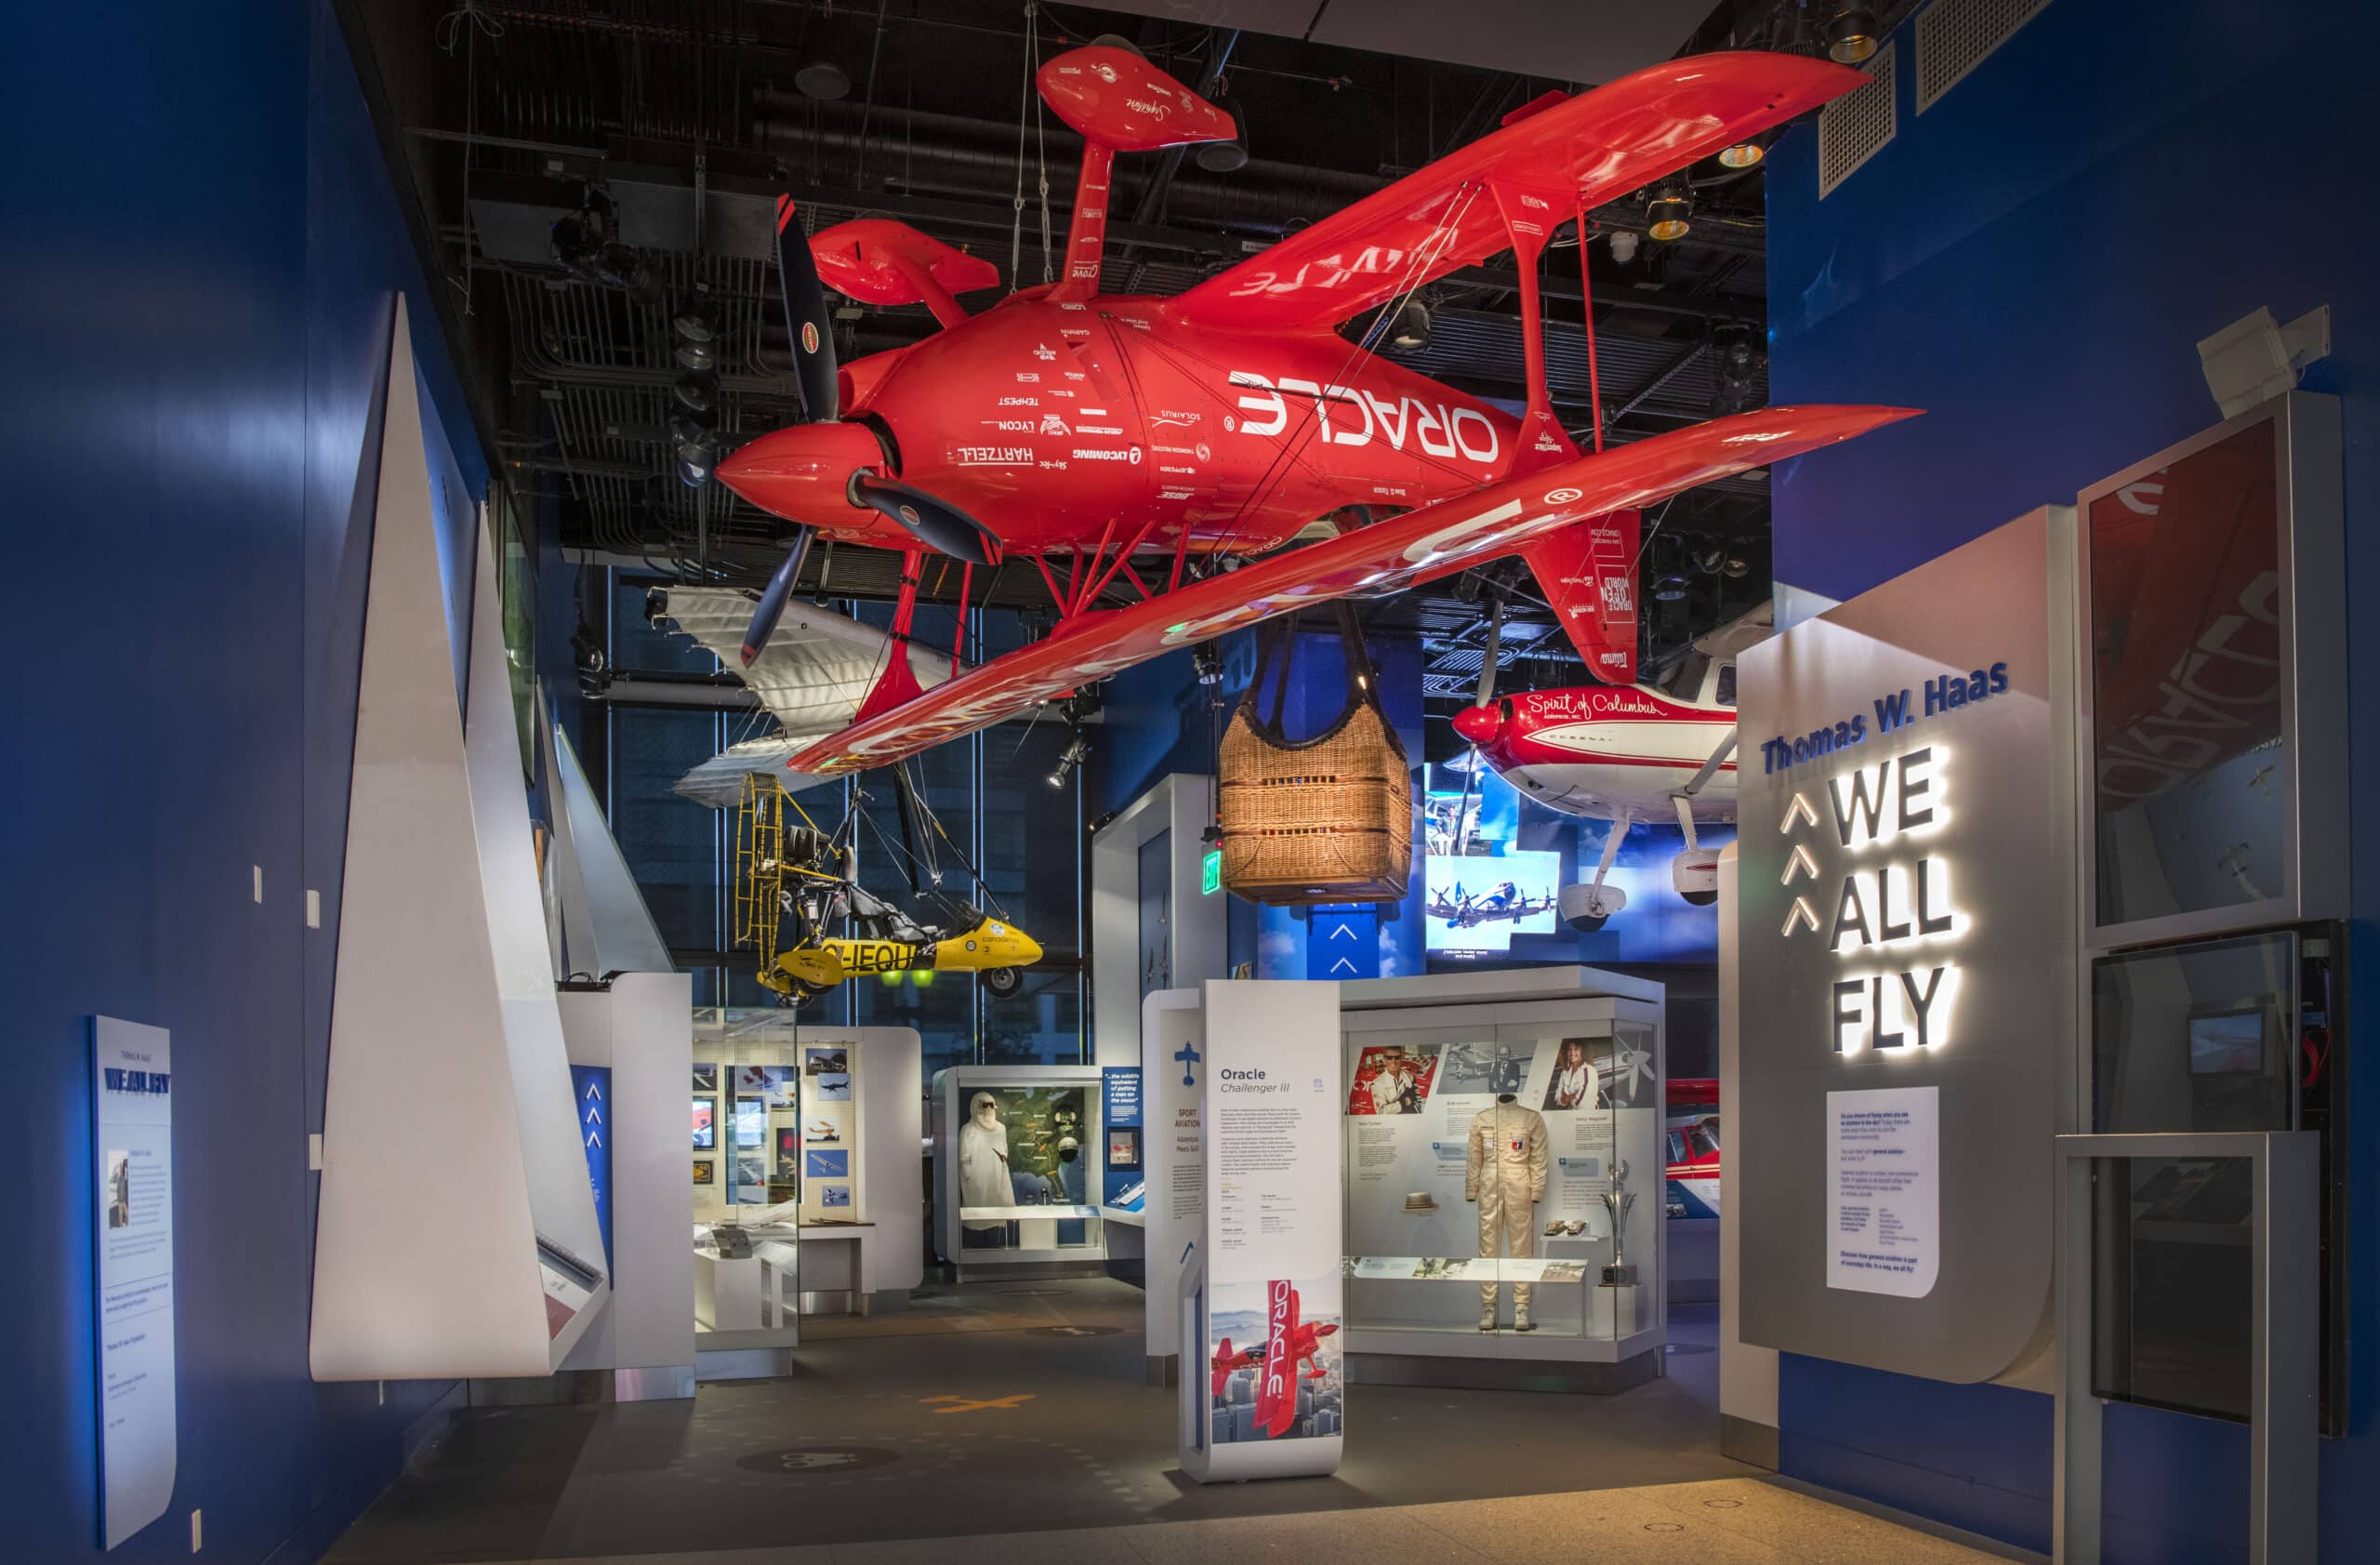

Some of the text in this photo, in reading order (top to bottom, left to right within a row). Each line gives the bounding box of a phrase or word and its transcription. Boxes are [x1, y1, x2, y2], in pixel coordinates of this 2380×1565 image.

[998, 396, 1039, 405] TEMPEST
[1161, 410, 1200, 420] SOLAIRUS
[1228, 370, 1498, 463] ORACLE
[998, 420, 1035, 431] LYCON
[958, 446, 1034, 463] HARTZELL
[1072, 449, 1128, 460] LYCOMING
[1527, 694, 1668, 720] Spirit of Columbus
[1761, 662, 2008, 775] Thomas W. Haas
[1828, 748, 1934, 847] WE
[1830, 858, 1952, 951] ALL
[1832, 966, 1946, 1053] FLY
[1221, 1068, 1266, 1080] Oracle
[1221, 1083, 1277, 1094] Challenger
[1175, 1120, 1200, 1128] AVIATION
[1266, 1280, 1289, 1398] ORACLE
